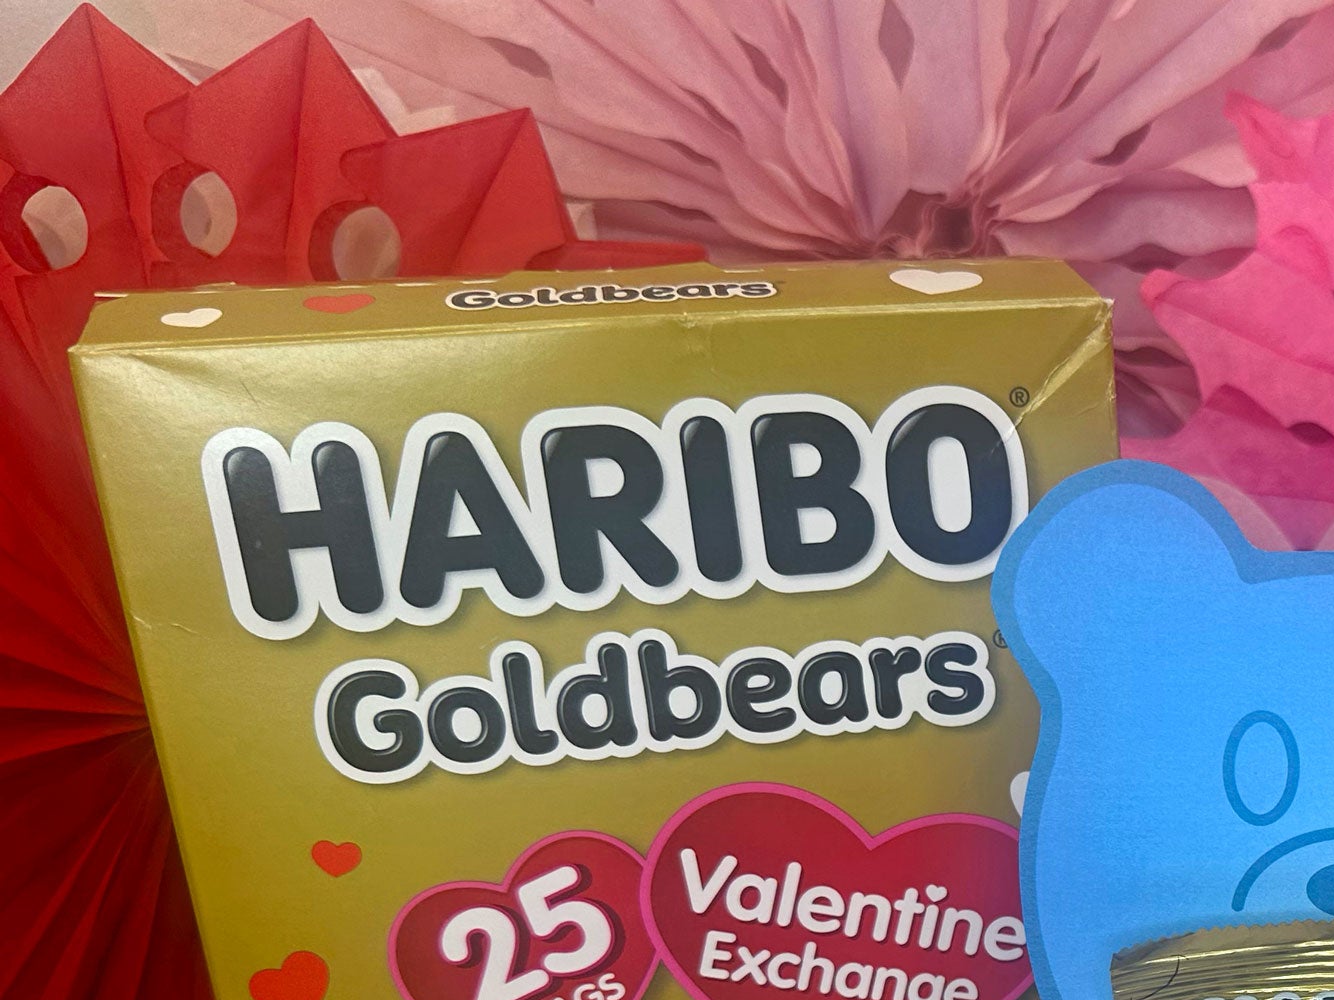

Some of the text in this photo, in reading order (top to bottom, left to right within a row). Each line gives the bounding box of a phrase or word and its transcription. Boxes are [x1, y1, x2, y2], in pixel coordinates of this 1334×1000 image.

[447, 281, 776, 311] Goldbears
[216, 398, 1018, 627] HARIBO
[322, 635, 992, 778] Goldbears
[679, 847, 1027, 963] Valentine
